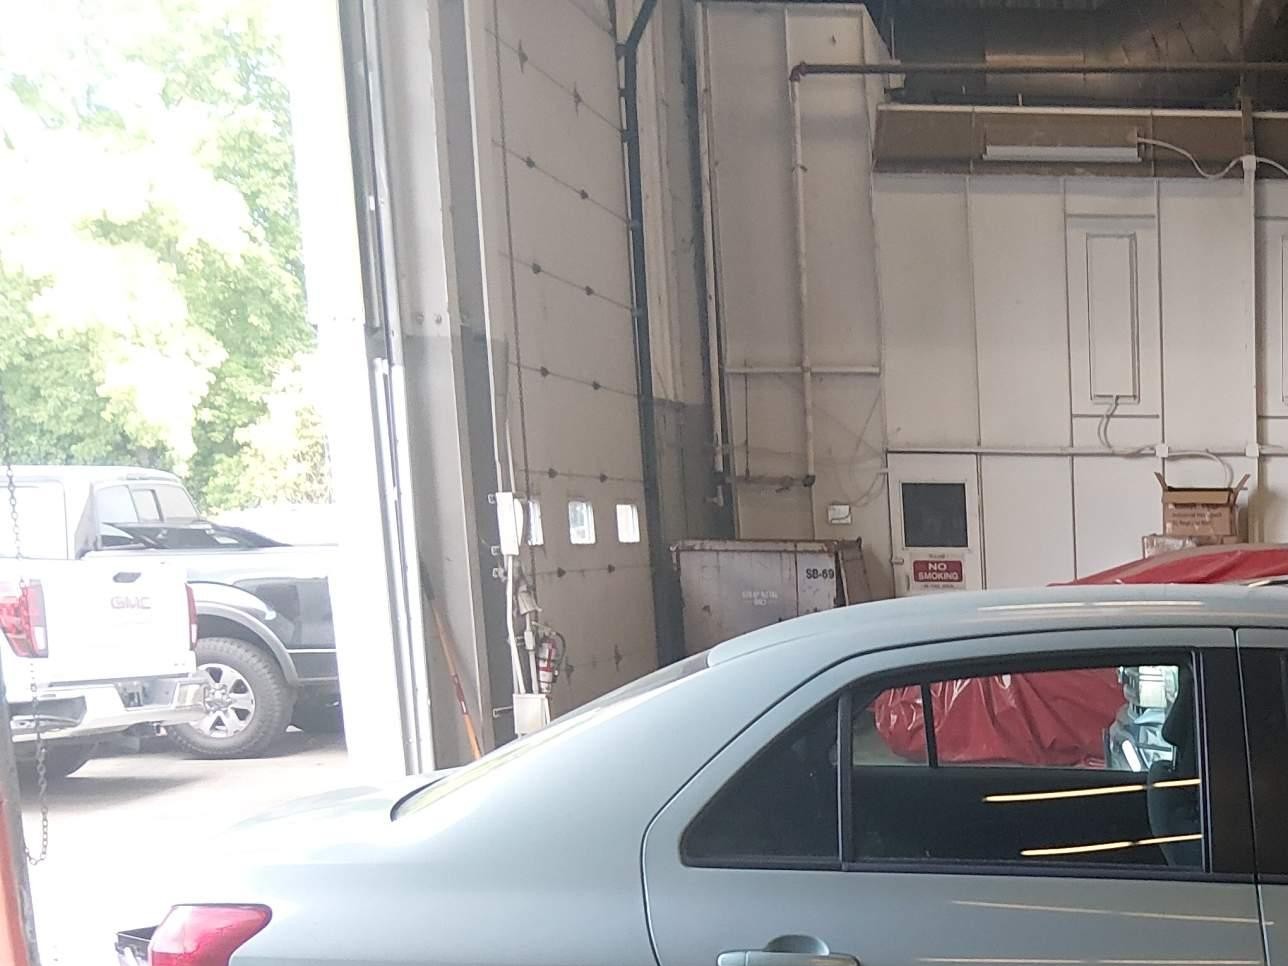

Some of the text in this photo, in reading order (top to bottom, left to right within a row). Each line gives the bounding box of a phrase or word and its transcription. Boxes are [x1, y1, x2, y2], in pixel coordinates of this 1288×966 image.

[928, 562, 947, 571] NO
[806, 568, 835, 580] SB-69
[918, 571, 960, 581] SMOKING
[111, 596, 152, 610] GMC
